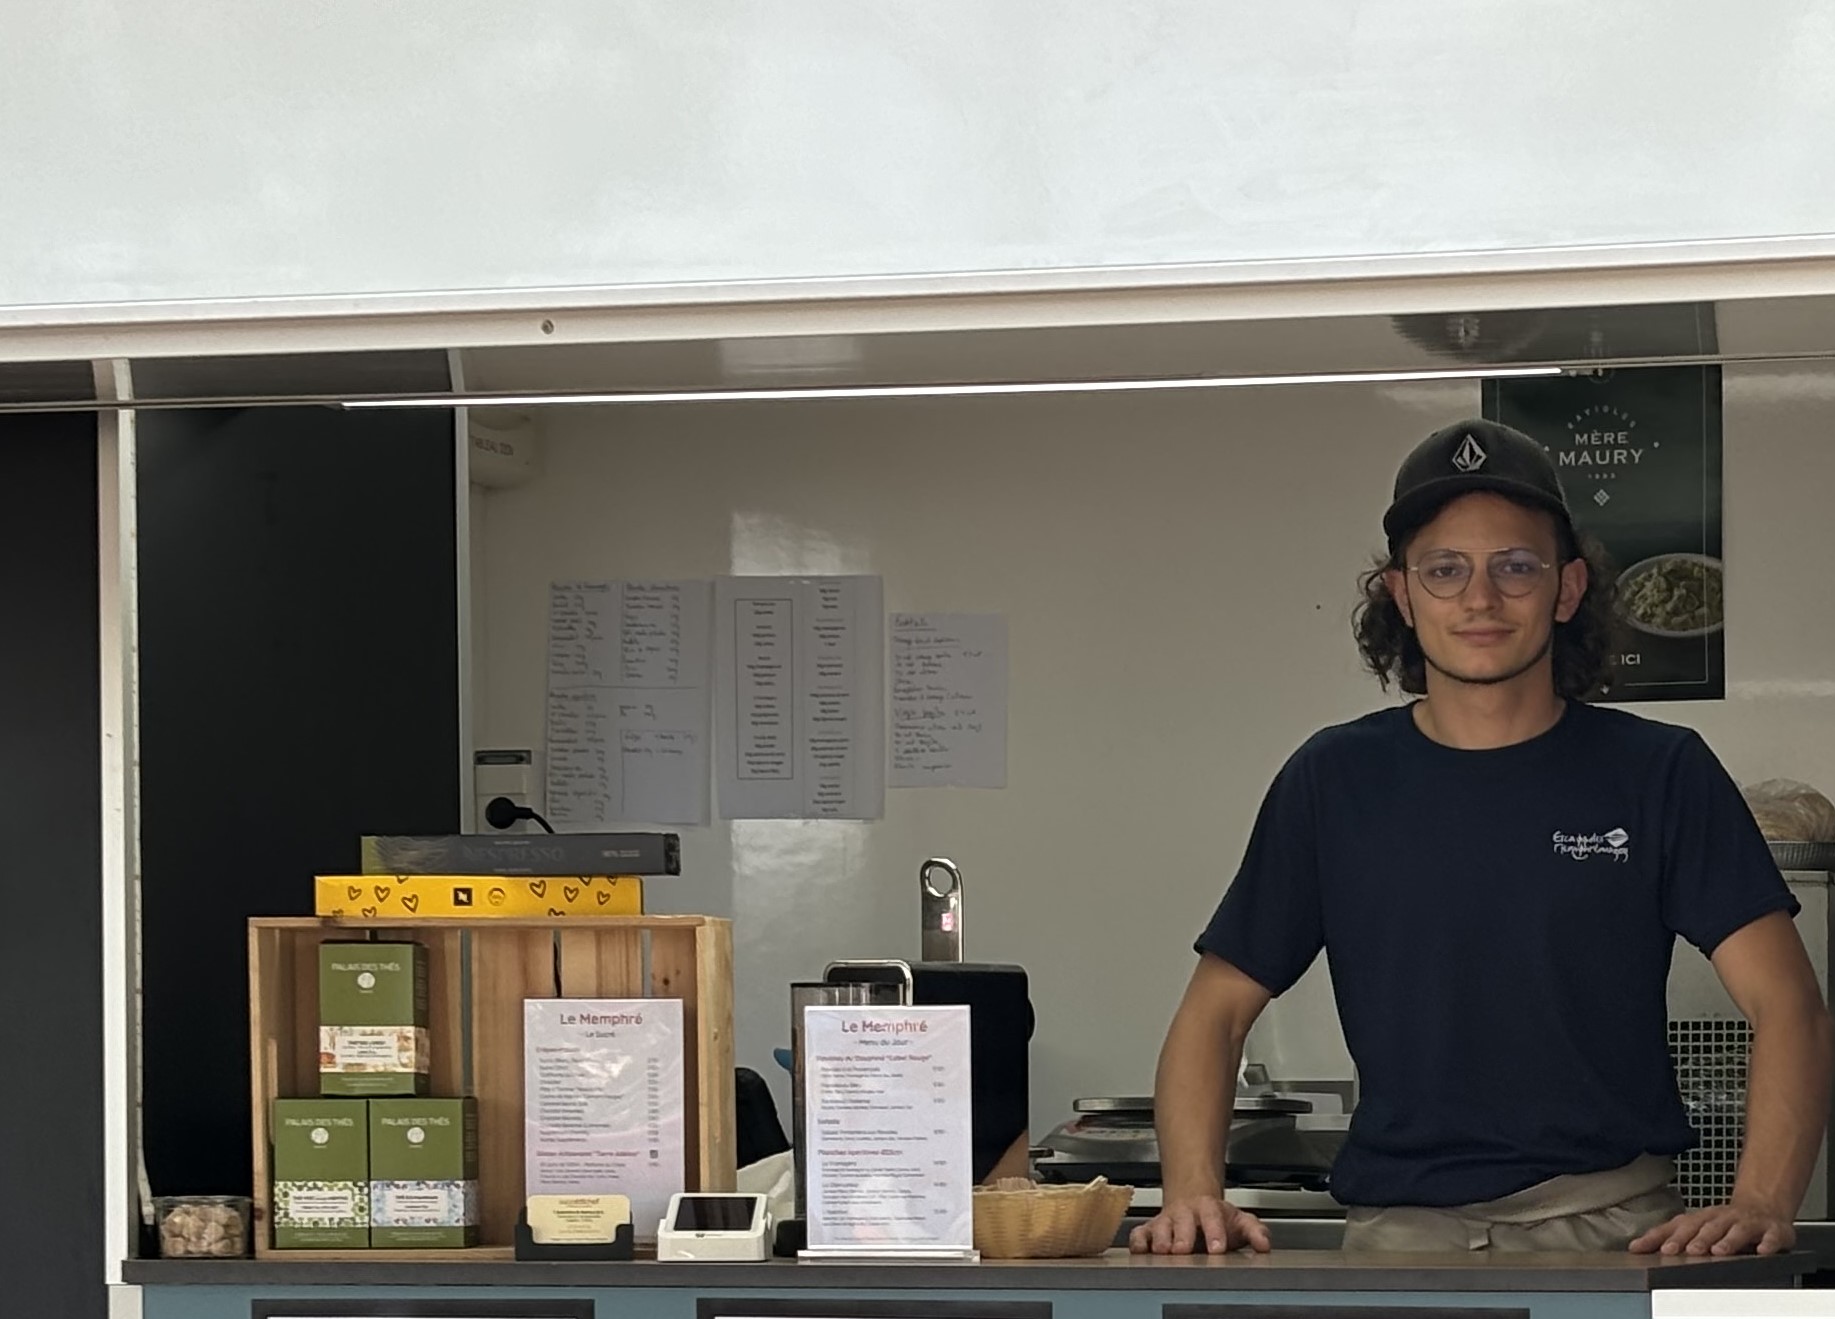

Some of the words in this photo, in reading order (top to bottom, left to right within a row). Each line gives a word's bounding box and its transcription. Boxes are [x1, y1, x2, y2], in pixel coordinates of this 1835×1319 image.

[1575, 429, 1629, 446] MÈRE
[1559, 448, 1643, 466] MAURY
[1621, 653, 1641, 666] ICI
[331, 962, 358, 971] PALAIS
[360, 963, 378, 971] DES
[560, 1014, 576, 1025] Le
[579, 1012, 643, 1026] Memphré
[842, 1020, 858, 1033] Le
[862, 1019, 928, 1035] Memphré
[285, 1118, 314, 1127] PALAIS
[316, 1118, 331, 1126] DES
[381, 1117, 410, 1126] PALAIS
[411, 1117, 427, 1126] DES
